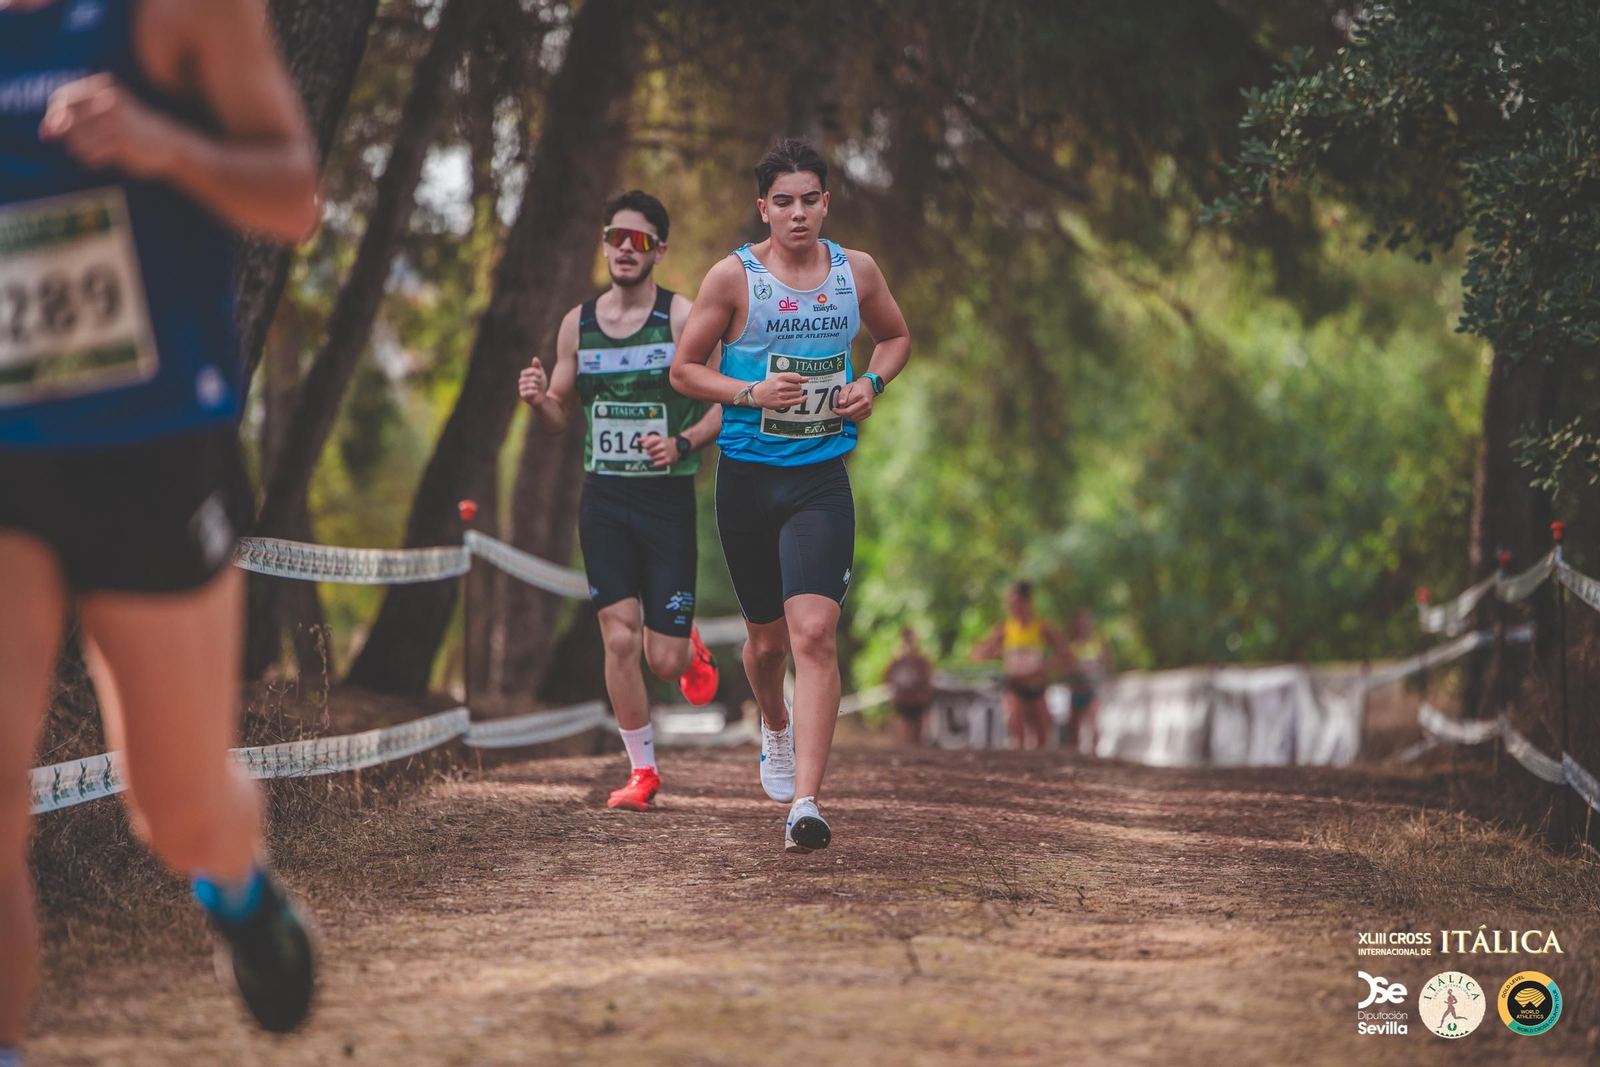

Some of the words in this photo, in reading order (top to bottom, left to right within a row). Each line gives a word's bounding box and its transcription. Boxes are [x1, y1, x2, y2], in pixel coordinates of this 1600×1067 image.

[766, 316, 848, 333] MARACENA
[795, 360, 834, 371] ITÁLICA
[774, 385, 842, 415] 170
[600, 430, 660, 454] 614
